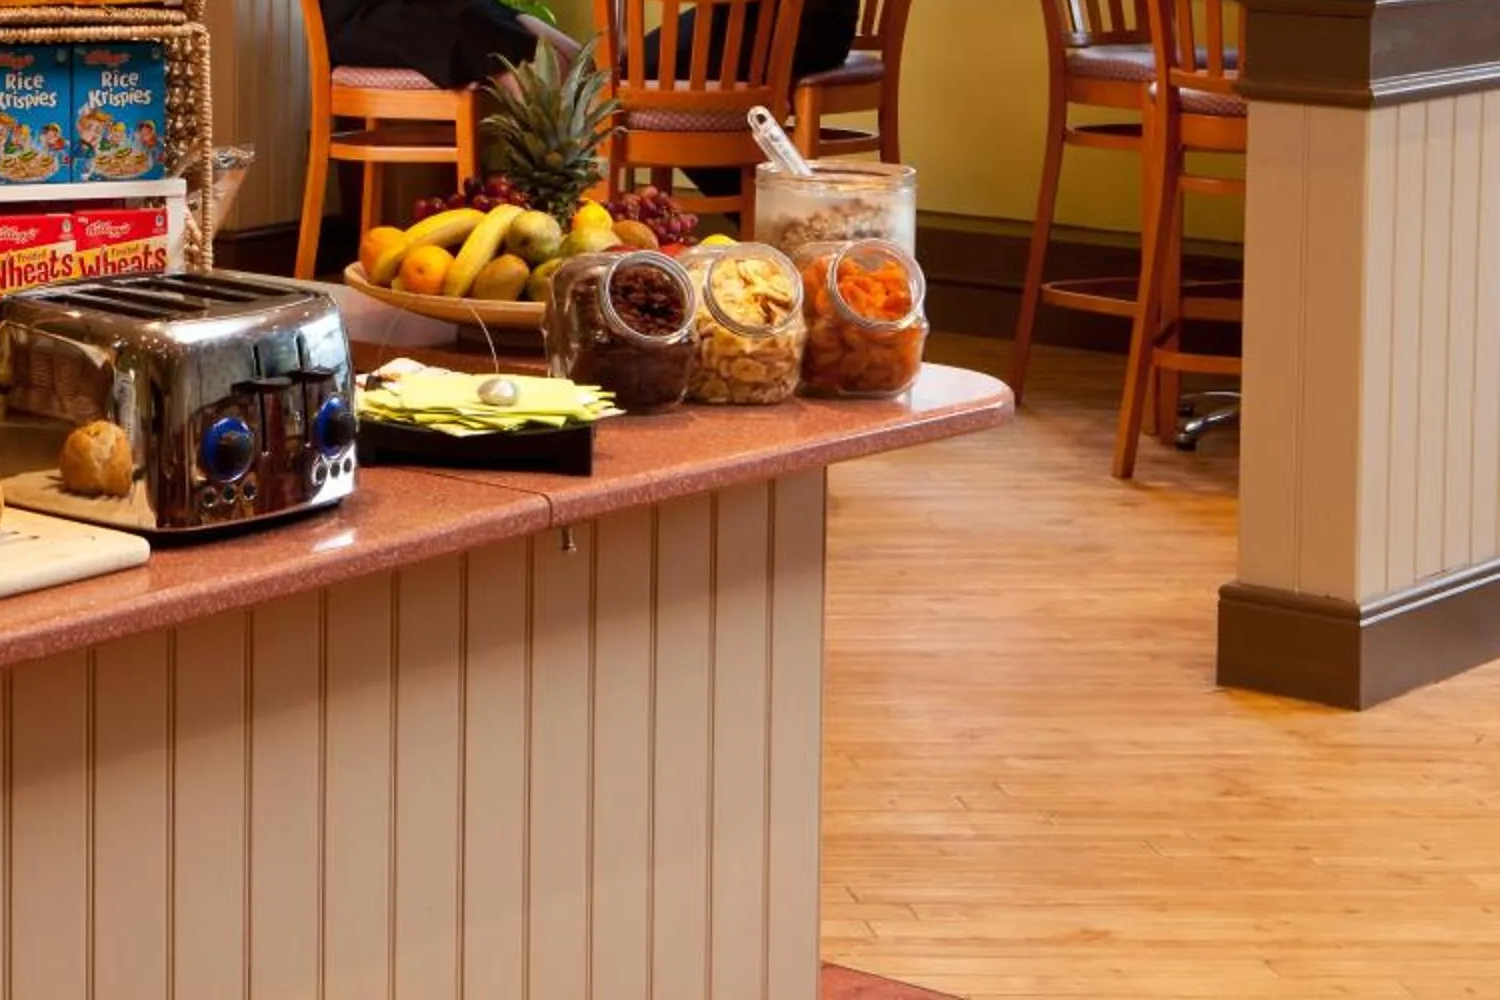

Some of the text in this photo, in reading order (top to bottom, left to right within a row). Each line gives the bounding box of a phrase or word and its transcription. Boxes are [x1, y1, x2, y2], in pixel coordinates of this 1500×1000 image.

[5, 71, 44, 90] Rice
[101, 70, 139, 88] Rice
[88, 87, 152, 109] Krispies
[79, 245, 166, 276] Wheats
